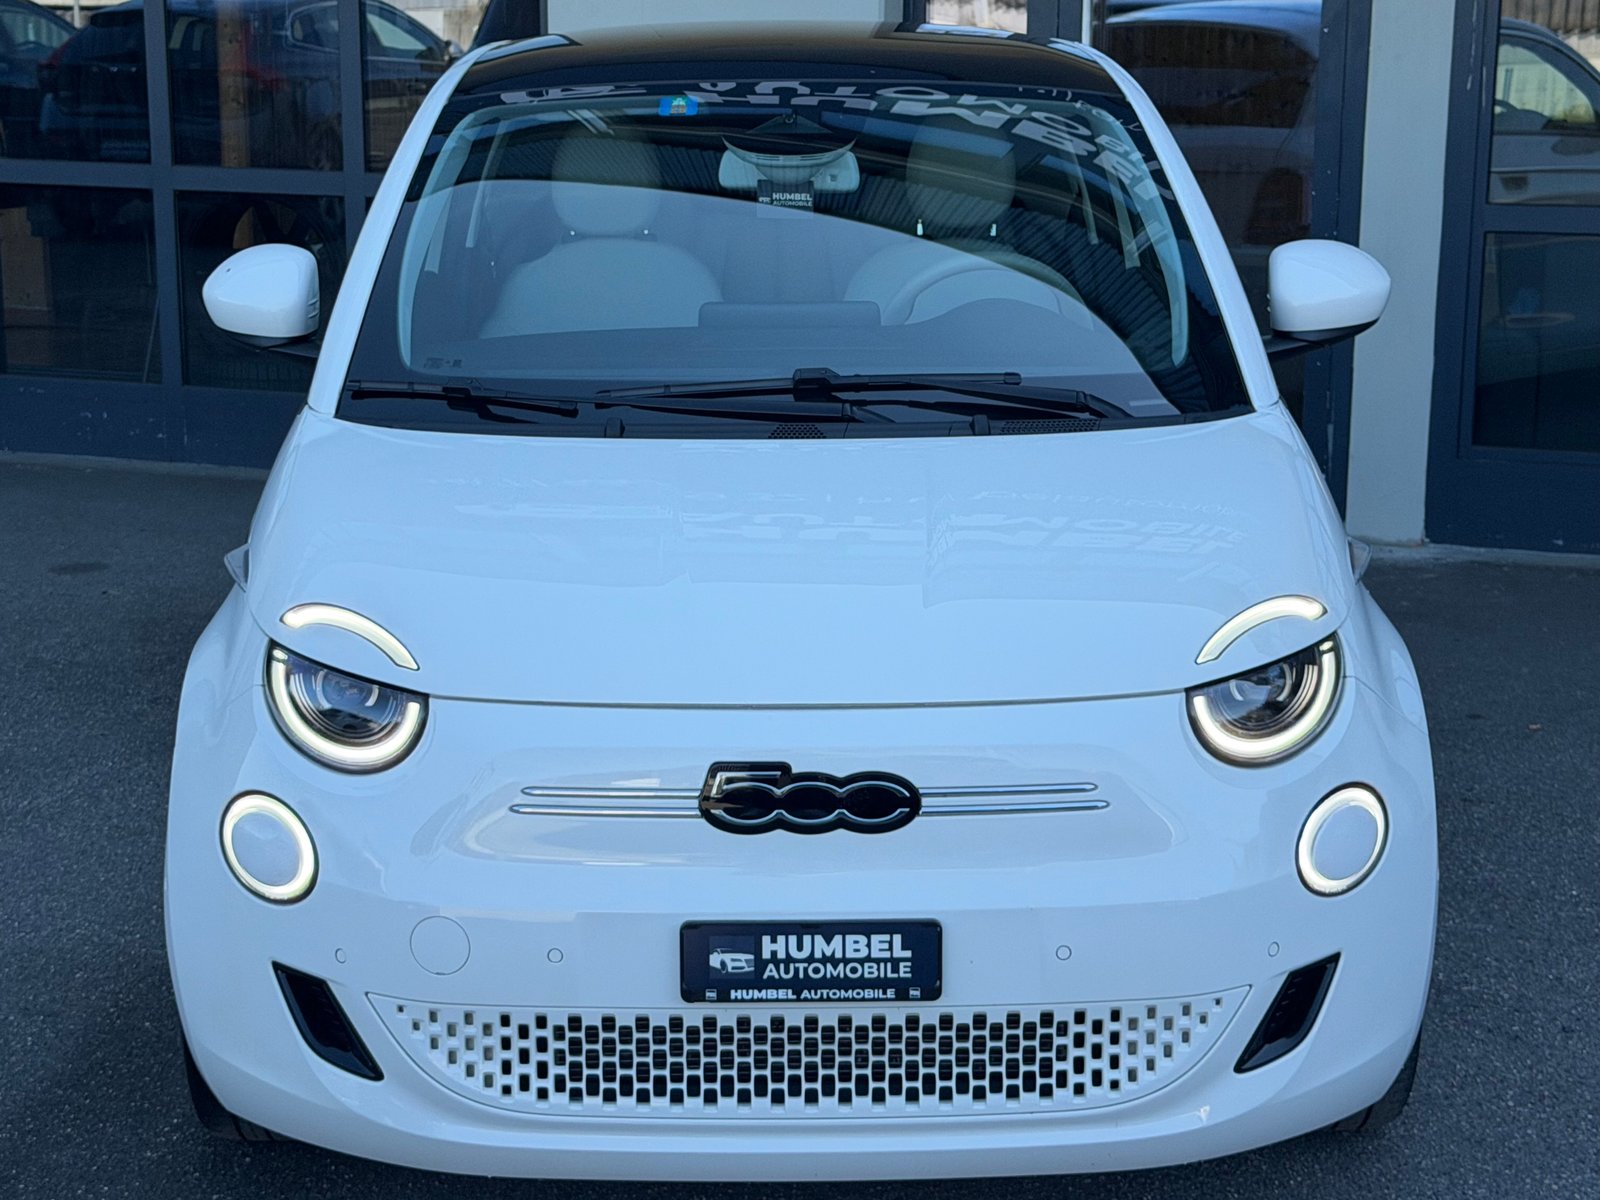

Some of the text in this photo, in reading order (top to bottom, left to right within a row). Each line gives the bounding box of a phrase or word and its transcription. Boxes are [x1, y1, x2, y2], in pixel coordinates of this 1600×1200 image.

[772, 192, 812, 201] HUMBEL
[703, 763, 918, 833] 500
[761, 933, 912, 960] HUMBEL
[762, 962, 912, 979] AUTOMOBILE
[730, 988, 896, 1000] HUMBEL AUTOMOBILE
